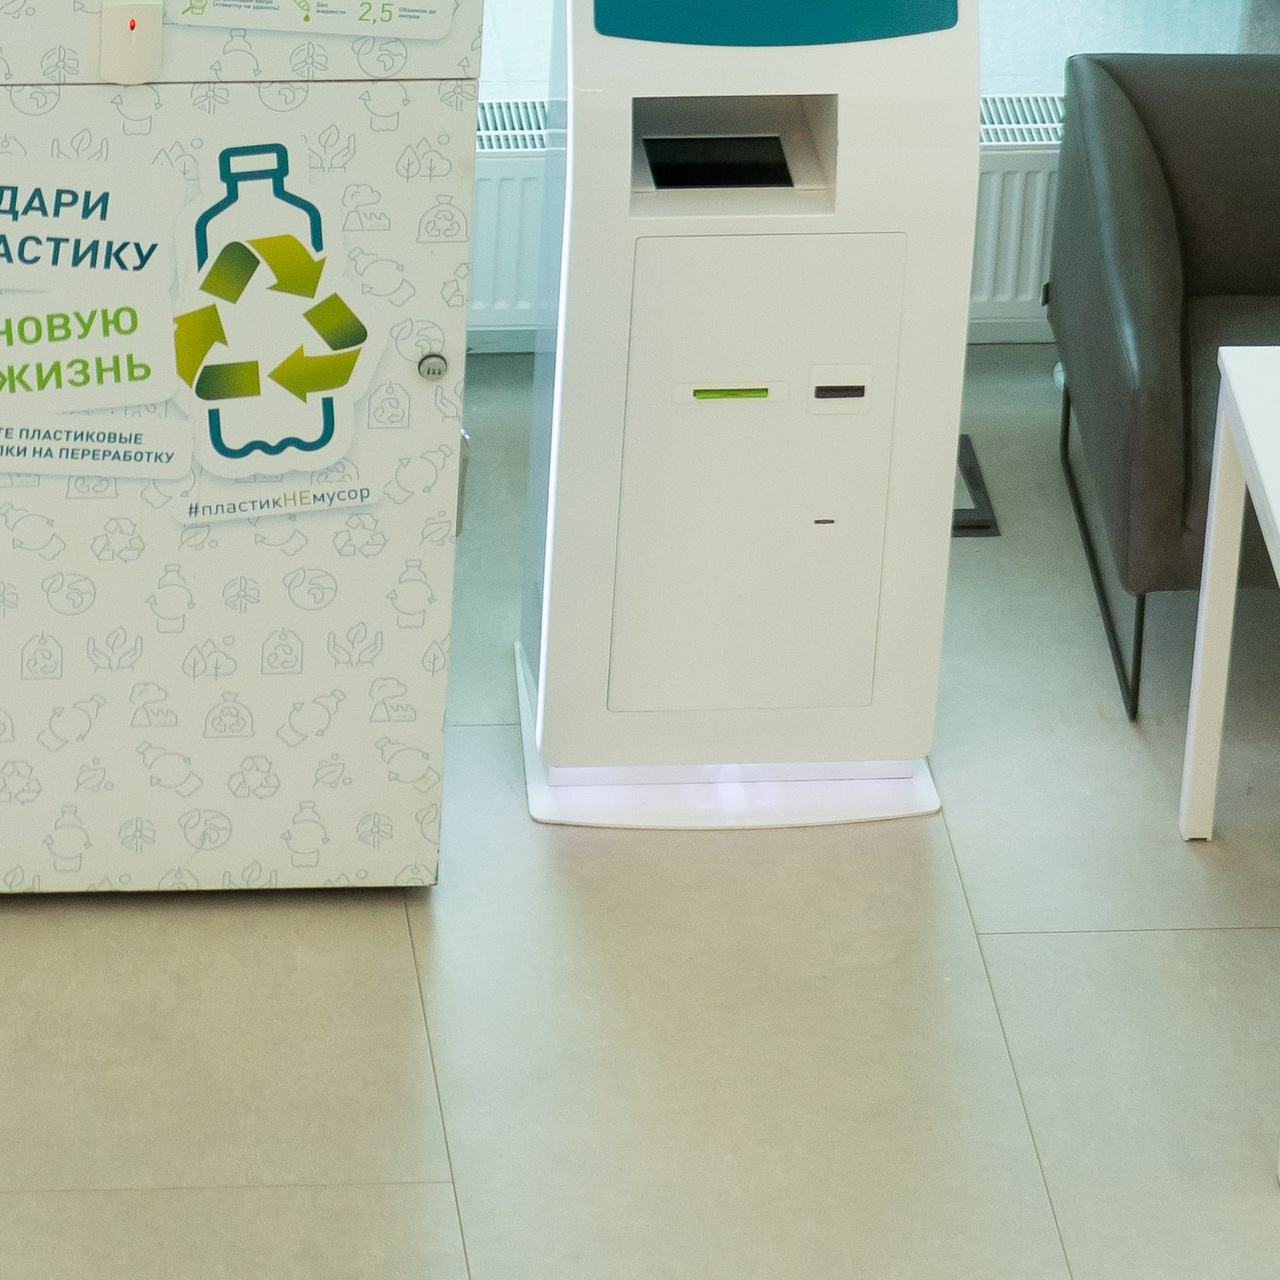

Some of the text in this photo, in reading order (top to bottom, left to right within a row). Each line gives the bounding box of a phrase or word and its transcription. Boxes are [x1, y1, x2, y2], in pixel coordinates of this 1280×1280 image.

[358, 1, 394, 25] 2,5
[18, 427, 144, 446] ПЛАСТИКОВЫЕ
[32, 445, 54, 459] НА
[58, 447, 175, 464] ПЕРЕРАБОТКУ
[187, 485, 371, 519] #пластикНЕмусор
